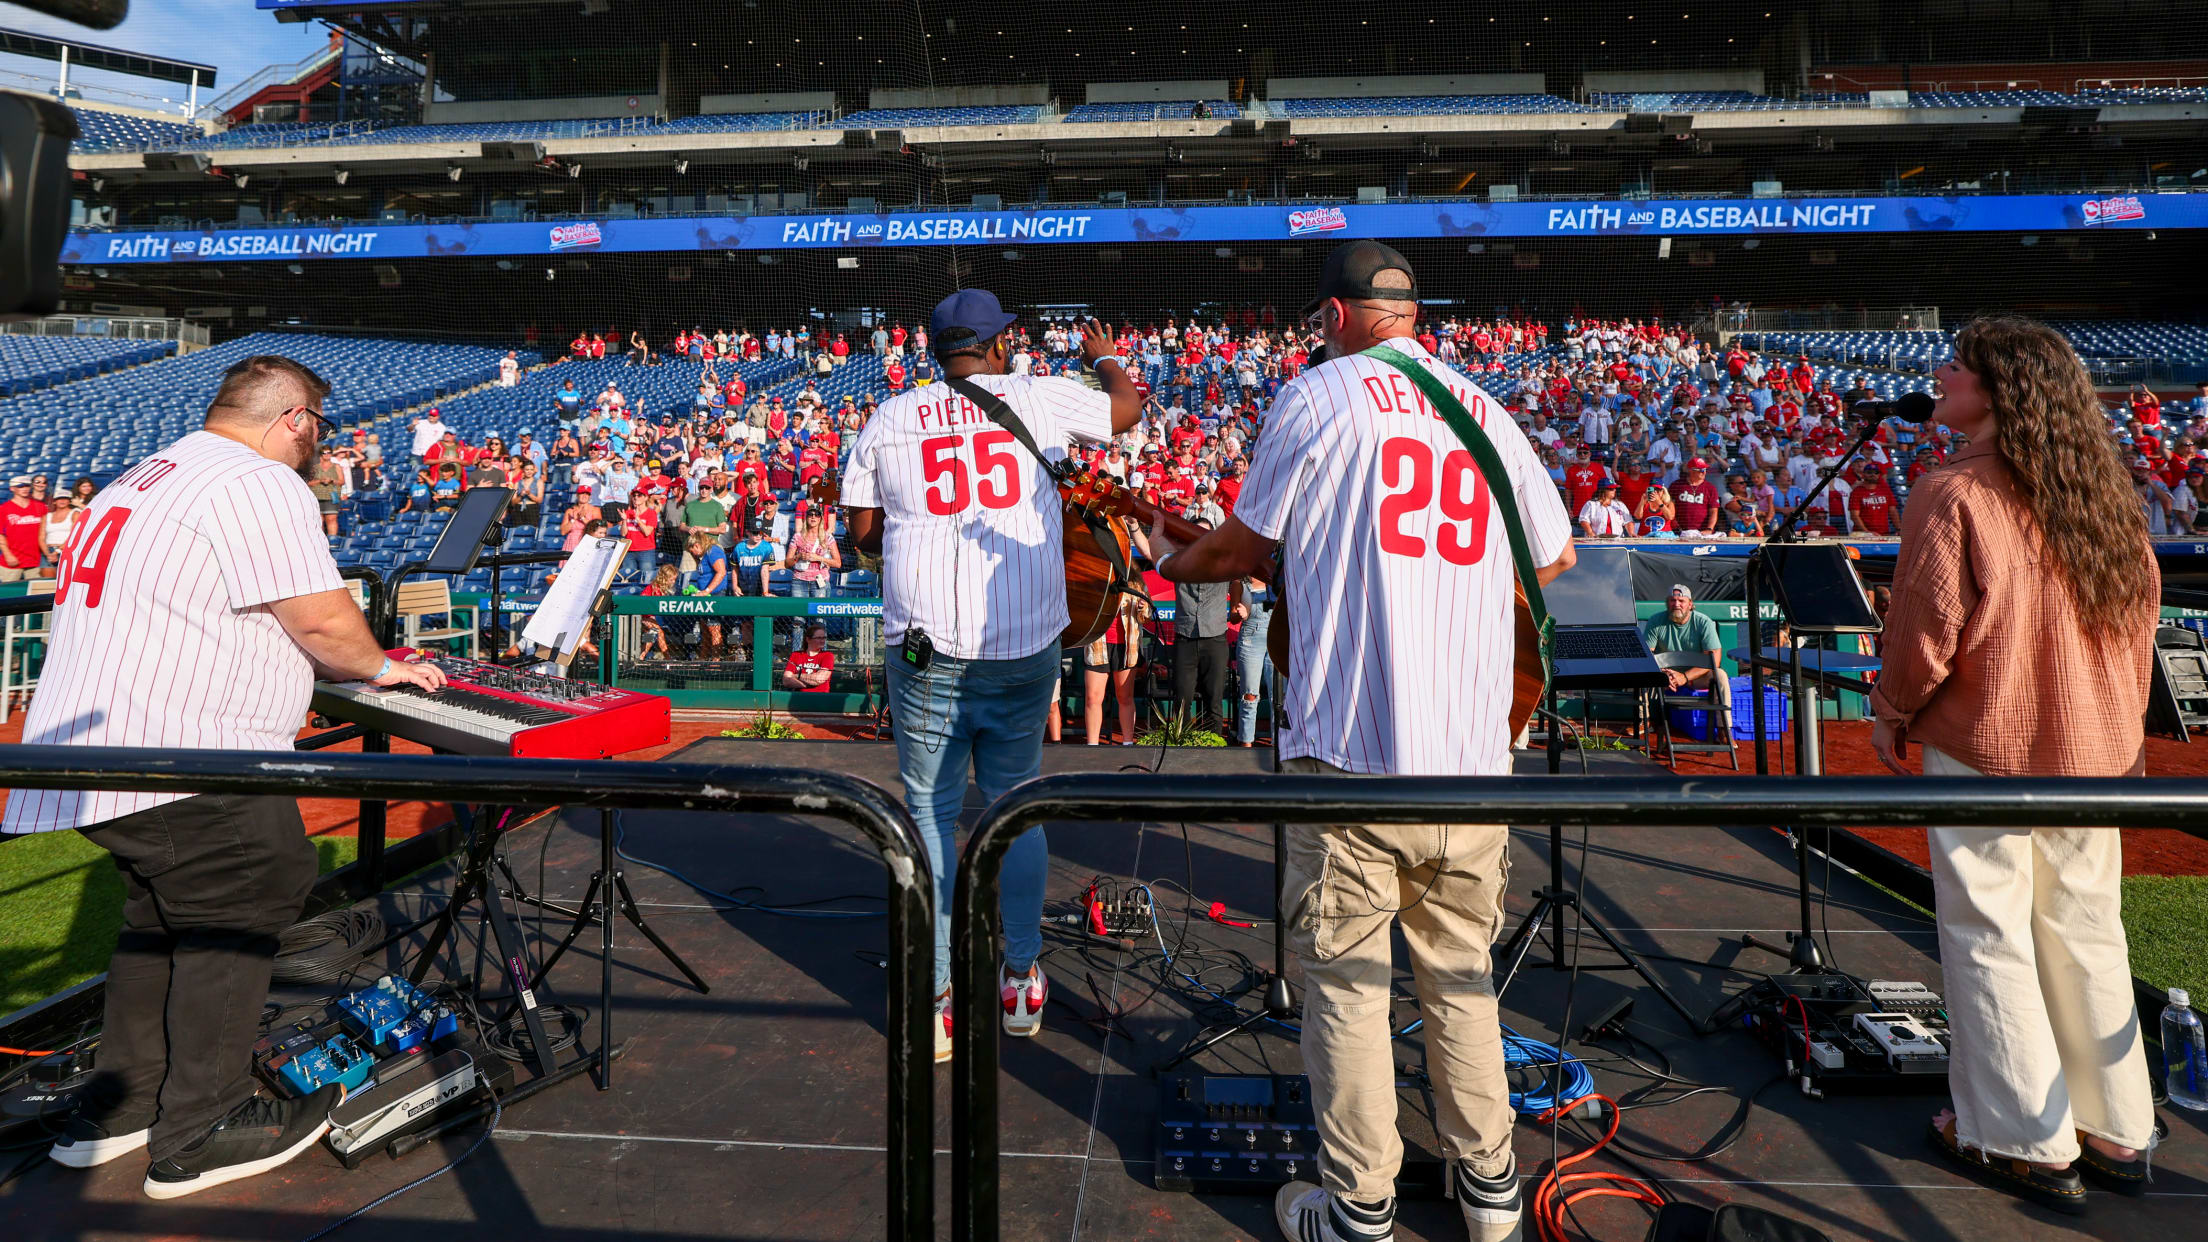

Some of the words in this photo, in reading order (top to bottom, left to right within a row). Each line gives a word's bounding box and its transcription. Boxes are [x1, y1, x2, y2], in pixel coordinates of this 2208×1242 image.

[782, 218, 851, 242] FAITH
[856, 224, 882, 236] AND
[887, 218, 1006, 241] BASEBALL
[1011, 216, 1091, 238] NIGHT
[1548, 204, 1621, 229] FAITH
[1627, 211, 1655, 224] AND
[1660, 206, 1788, 228] BASEBALL
[1792, 204, 1876, 226] NIGHT
[108, 234, 170, 258] FAITH
[172, 240, 196, 252] AND
[198, 235, 303, 256] BASEBALL
[305, 232, 378, 254] NIGHT
[921, 430, 1021, 516] 55
[1379, 436, 1491, 566] 29
[1678, 491, 1704, 504] dad
[54, 506, 132, 609] 84
[658, 600, 716, 613] RE/MAX
[816, 603, 884, 615] smartwater
